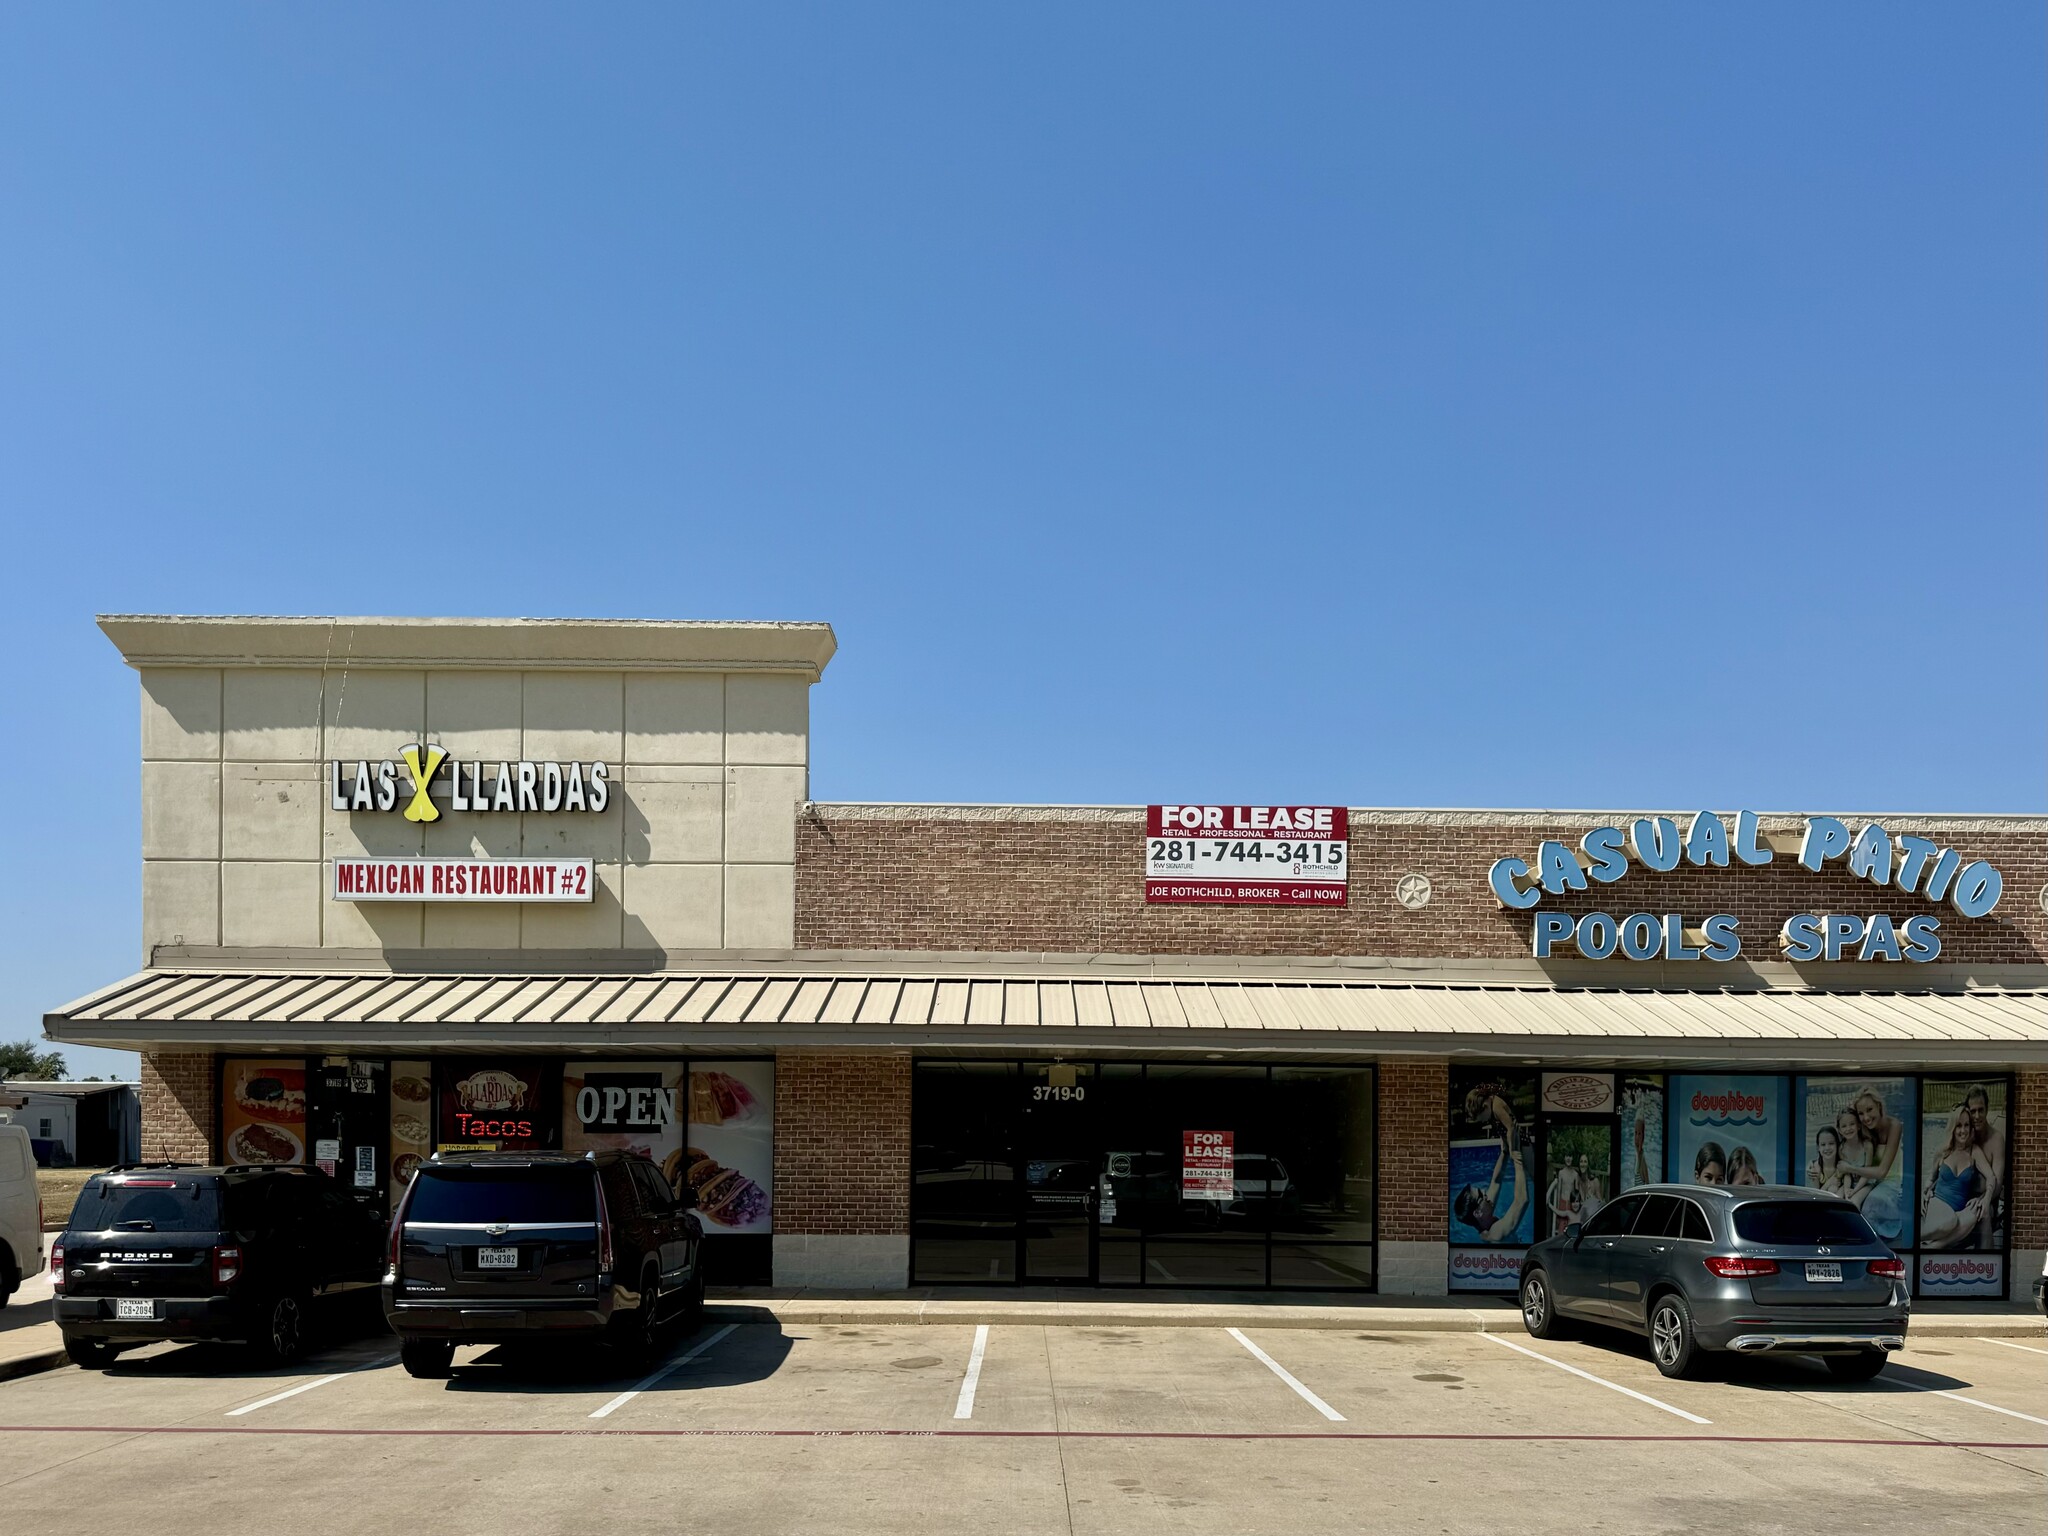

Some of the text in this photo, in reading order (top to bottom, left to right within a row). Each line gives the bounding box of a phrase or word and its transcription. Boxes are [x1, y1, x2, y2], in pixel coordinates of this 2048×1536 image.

[332, 759, 398, 812] LAS
[1161, 806, 1333, 830] FOR LEASE
[1162, 829, 1192, 837] RETAIL
[1200, 830, 1266, 838] PROFESSIONAL
[1273, 831, 1332, 839] RESTAURANT
[1151, 840, 1343, 864] 281-744-3415
[1488, 809, 2003, 918] CASUAL PATIO
[338, 864, 587, 895] MEXICAN RESTAURANT #2
[1150, 886, 1168, 896] JOE
[1171, 887, 1235, 898] ROTHCHILD,
[1238, 888, 1280, 898] BROKER
[1291, 889, 1311, 899] Call
[1314, 890, 1343, 899] NOW!
[1532, 911, 1942, 963] POOLS SPAS
[576, 1086, 678, 1125] OPEN
[1033, 1086, 1085, 1101] 3719-0
[1692, 1090, 1764, 1118] doughboy
[456, 1114, 532, 1137] Tacos
[1194, 1133, 1223, 1145] FOR
[1185, 1146, 1232, 1157] LEASE
[1923, 1259, 1994, 1279] doughboy
